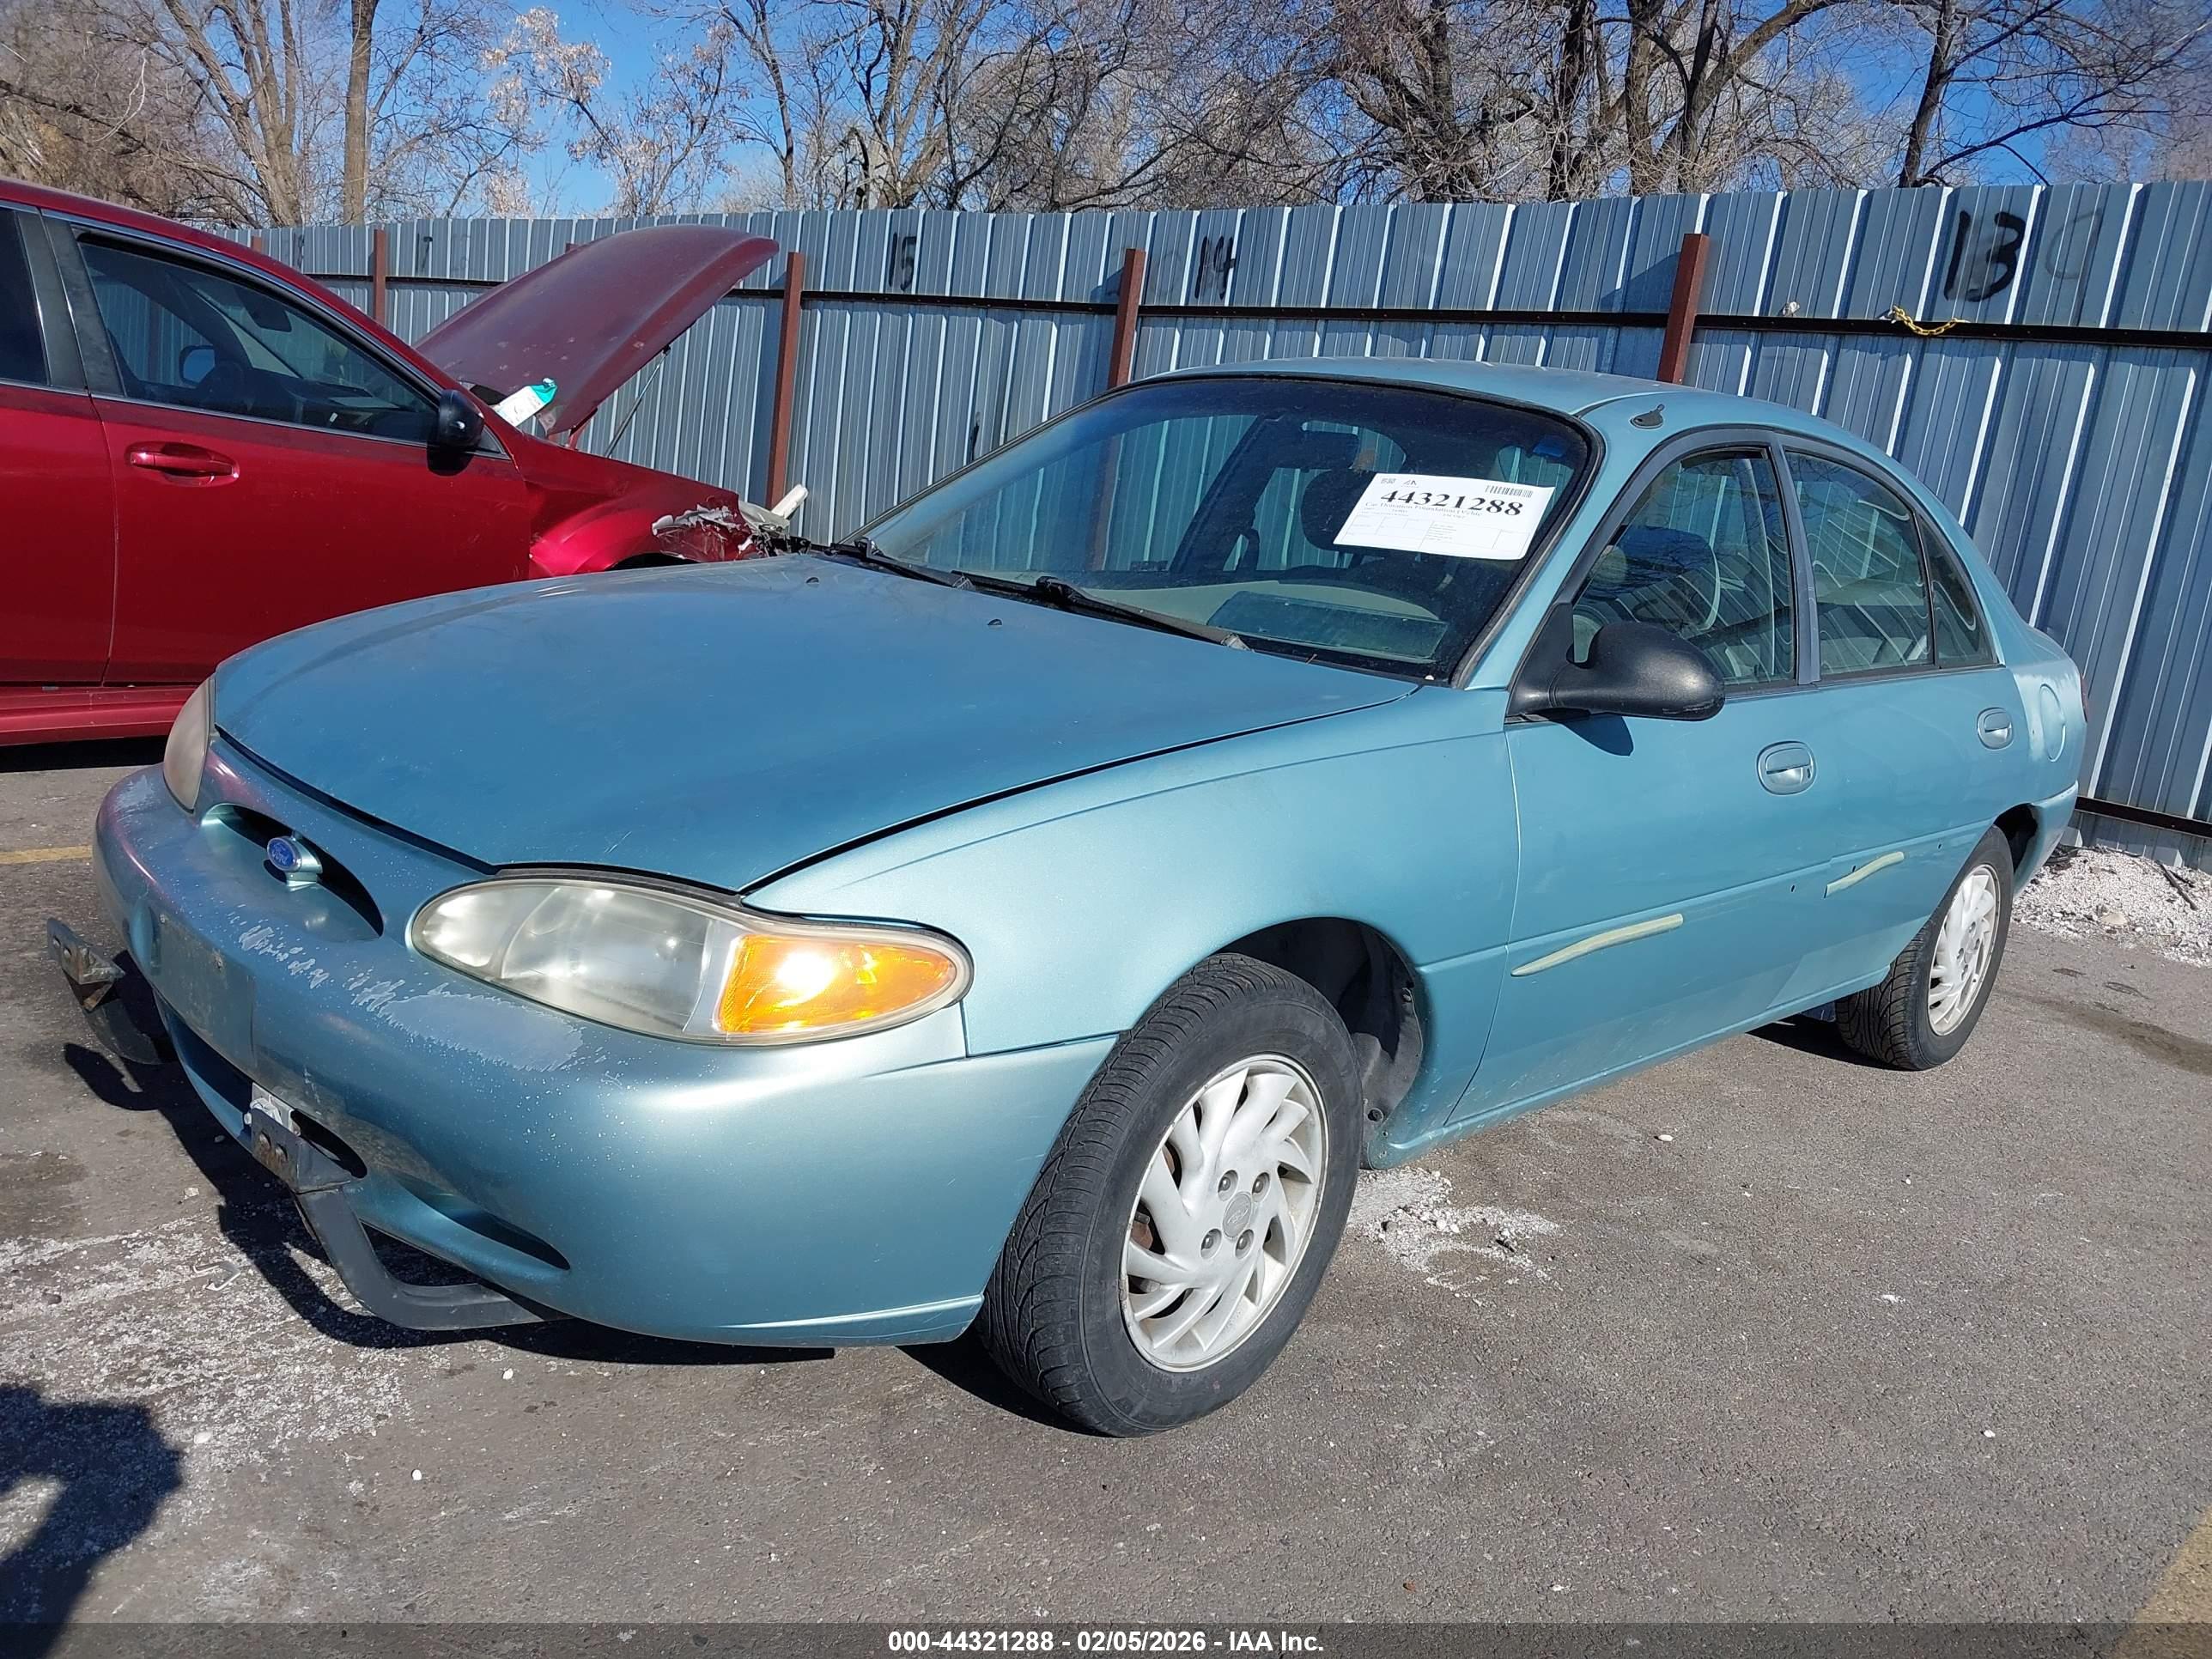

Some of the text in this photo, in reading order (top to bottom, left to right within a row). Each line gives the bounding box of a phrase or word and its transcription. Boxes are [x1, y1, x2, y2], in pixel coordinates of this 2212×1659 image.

[888, 231, 916, 292] 15
[1194, 235, 1237, 301] 14
[1943, 210, 2027, 302] 13
[1380, 489, 1523, 516] 44321288
